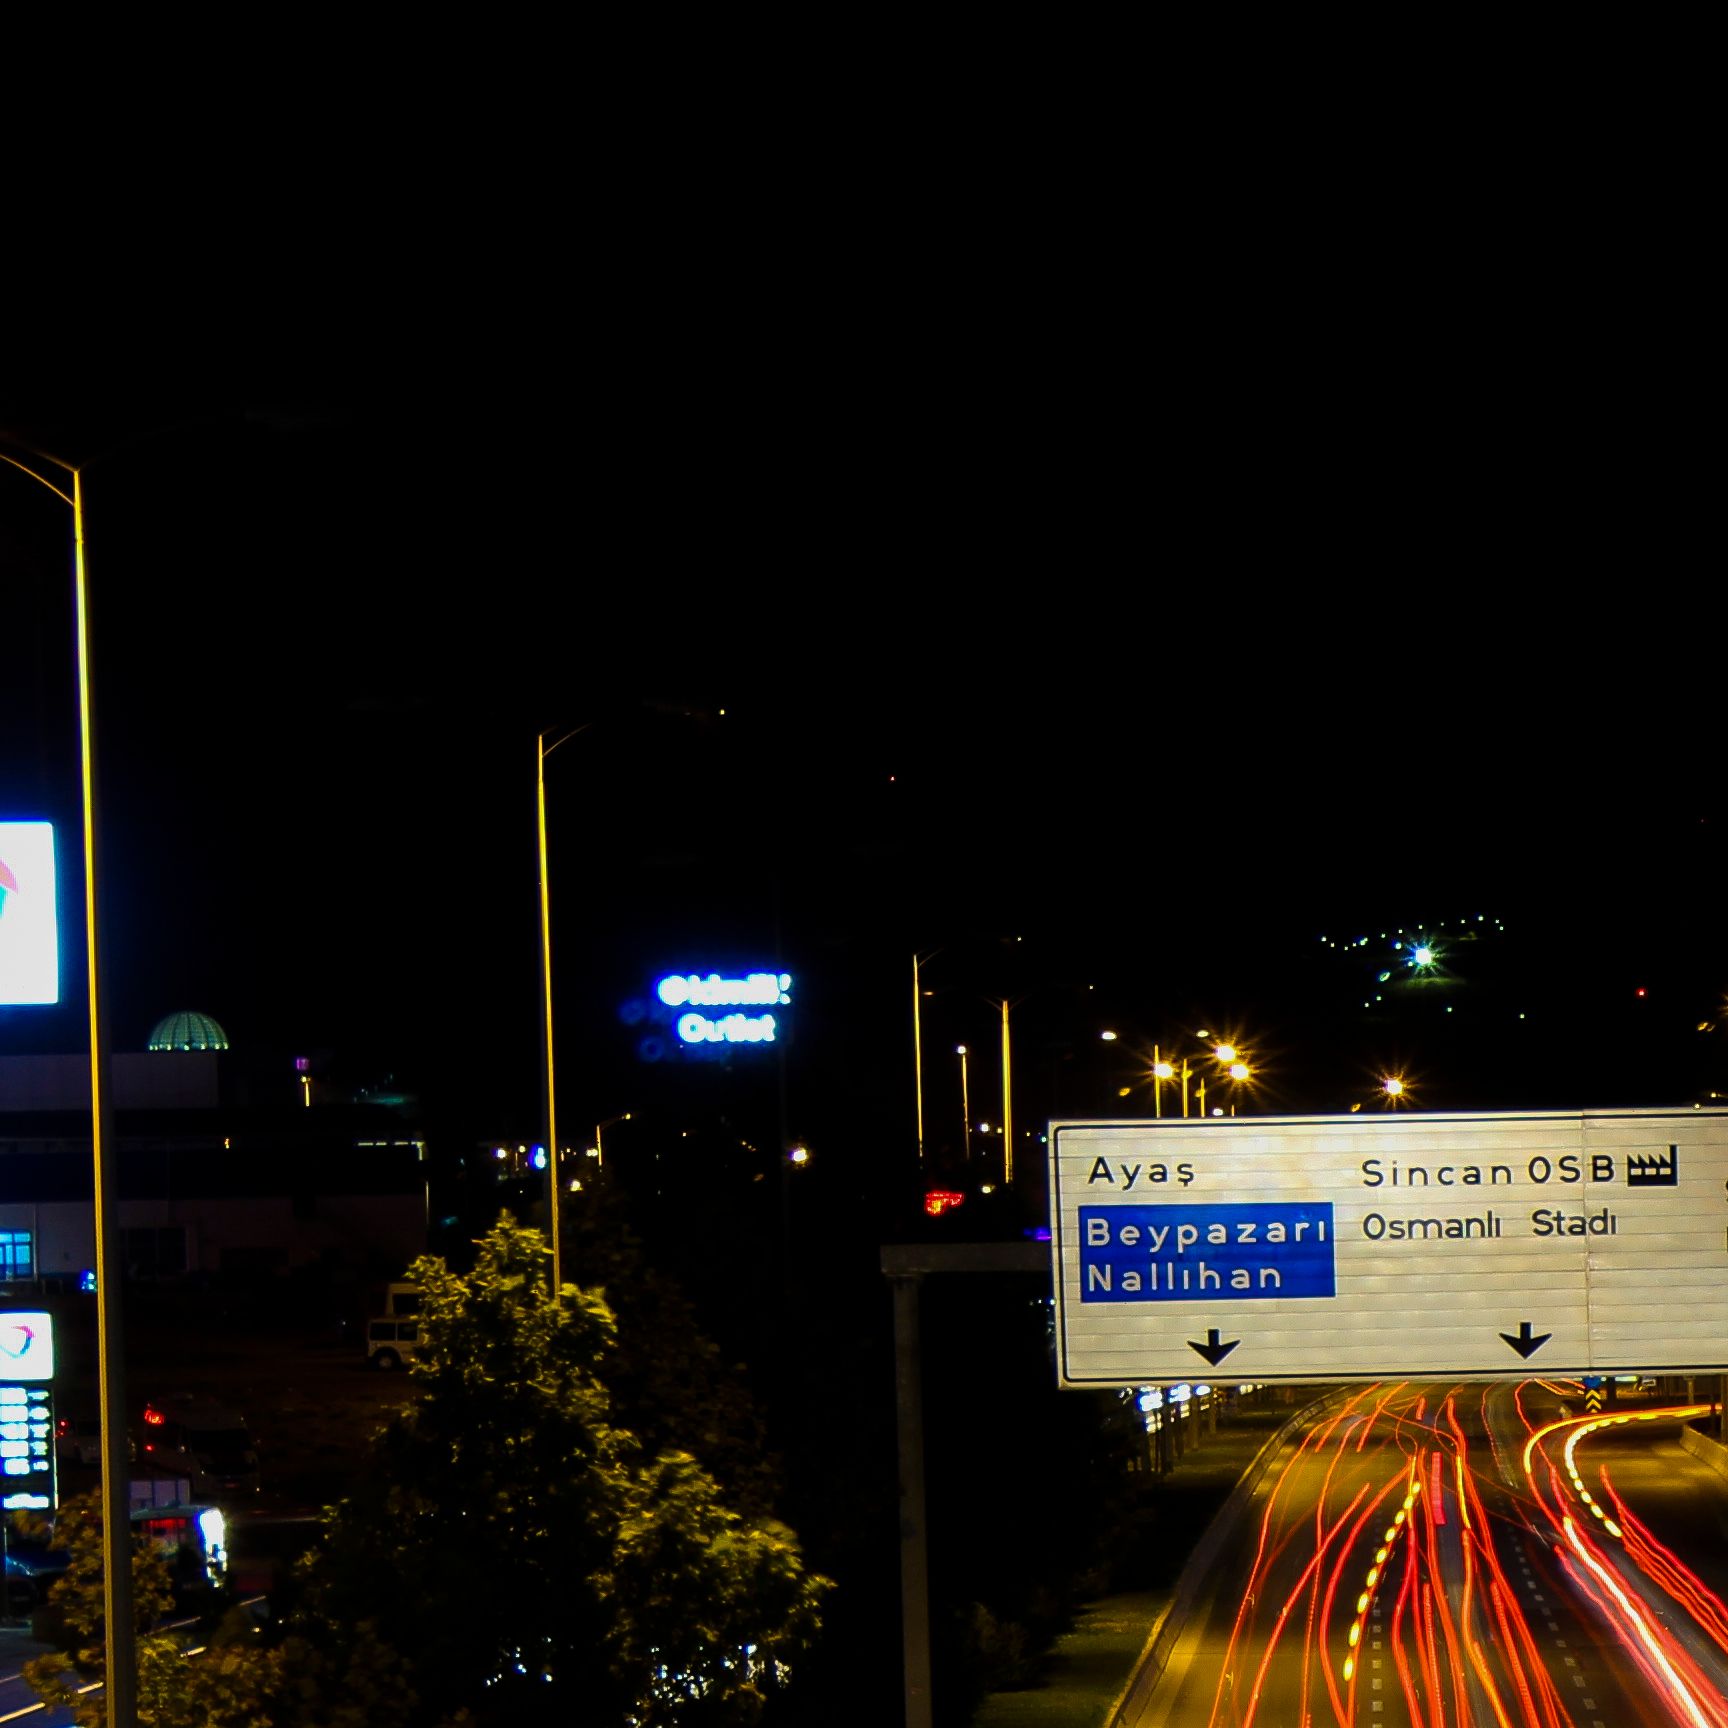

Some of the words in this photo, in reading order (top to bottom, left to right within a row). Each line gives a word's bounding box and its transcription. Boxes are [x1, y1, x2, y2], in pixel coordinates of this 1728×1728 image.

[1088, 1156, 1194, 1190] Ayaş
[1362, 1159, 1513, 1188] Sincan
[1528, 1155, 1615, 1184] OSB
[1087, 1218, 1327, 1253] Beypazarı
[1363, 1211, 1501, 1240] Osmanlı
[1532, 1208, 1617, 1238] Stadı
[1088, 1261, 1282, 1292] Nallıhan
